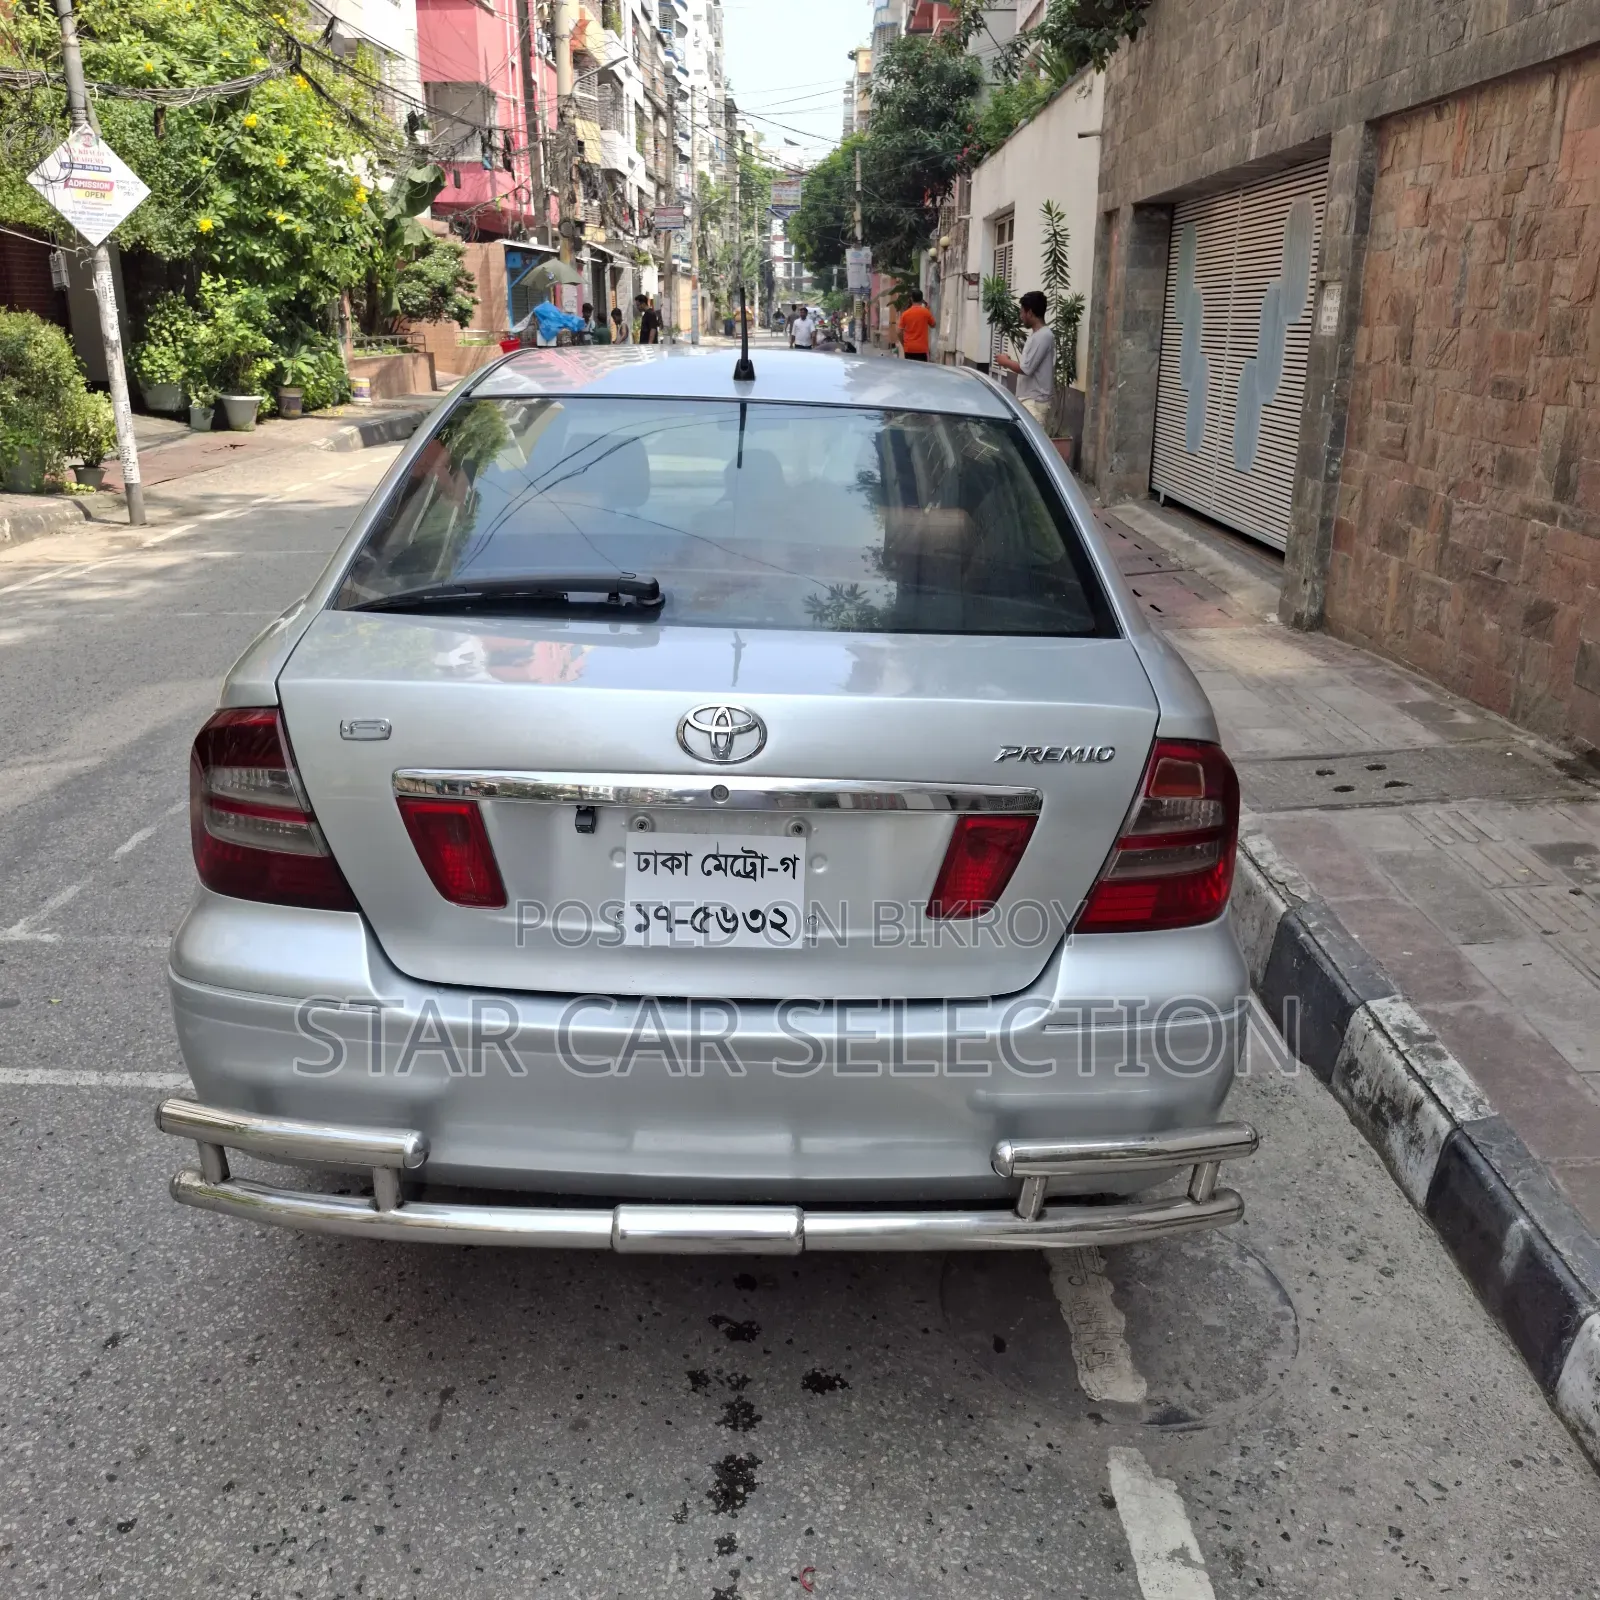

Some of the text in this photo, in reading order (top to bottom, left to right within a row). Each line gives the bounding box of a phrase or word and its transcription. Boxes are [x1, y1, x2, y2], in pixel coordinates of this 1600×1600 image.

[67, 179, 111, 190] ADMISSION
[84, 190, 106, 199] OPEN
[993, 745, 1116, 764] PREMIO
[633, 850, 693, 876] ঢাকা
[634, 904, 791, 940] ১৭-৫৬৩২
